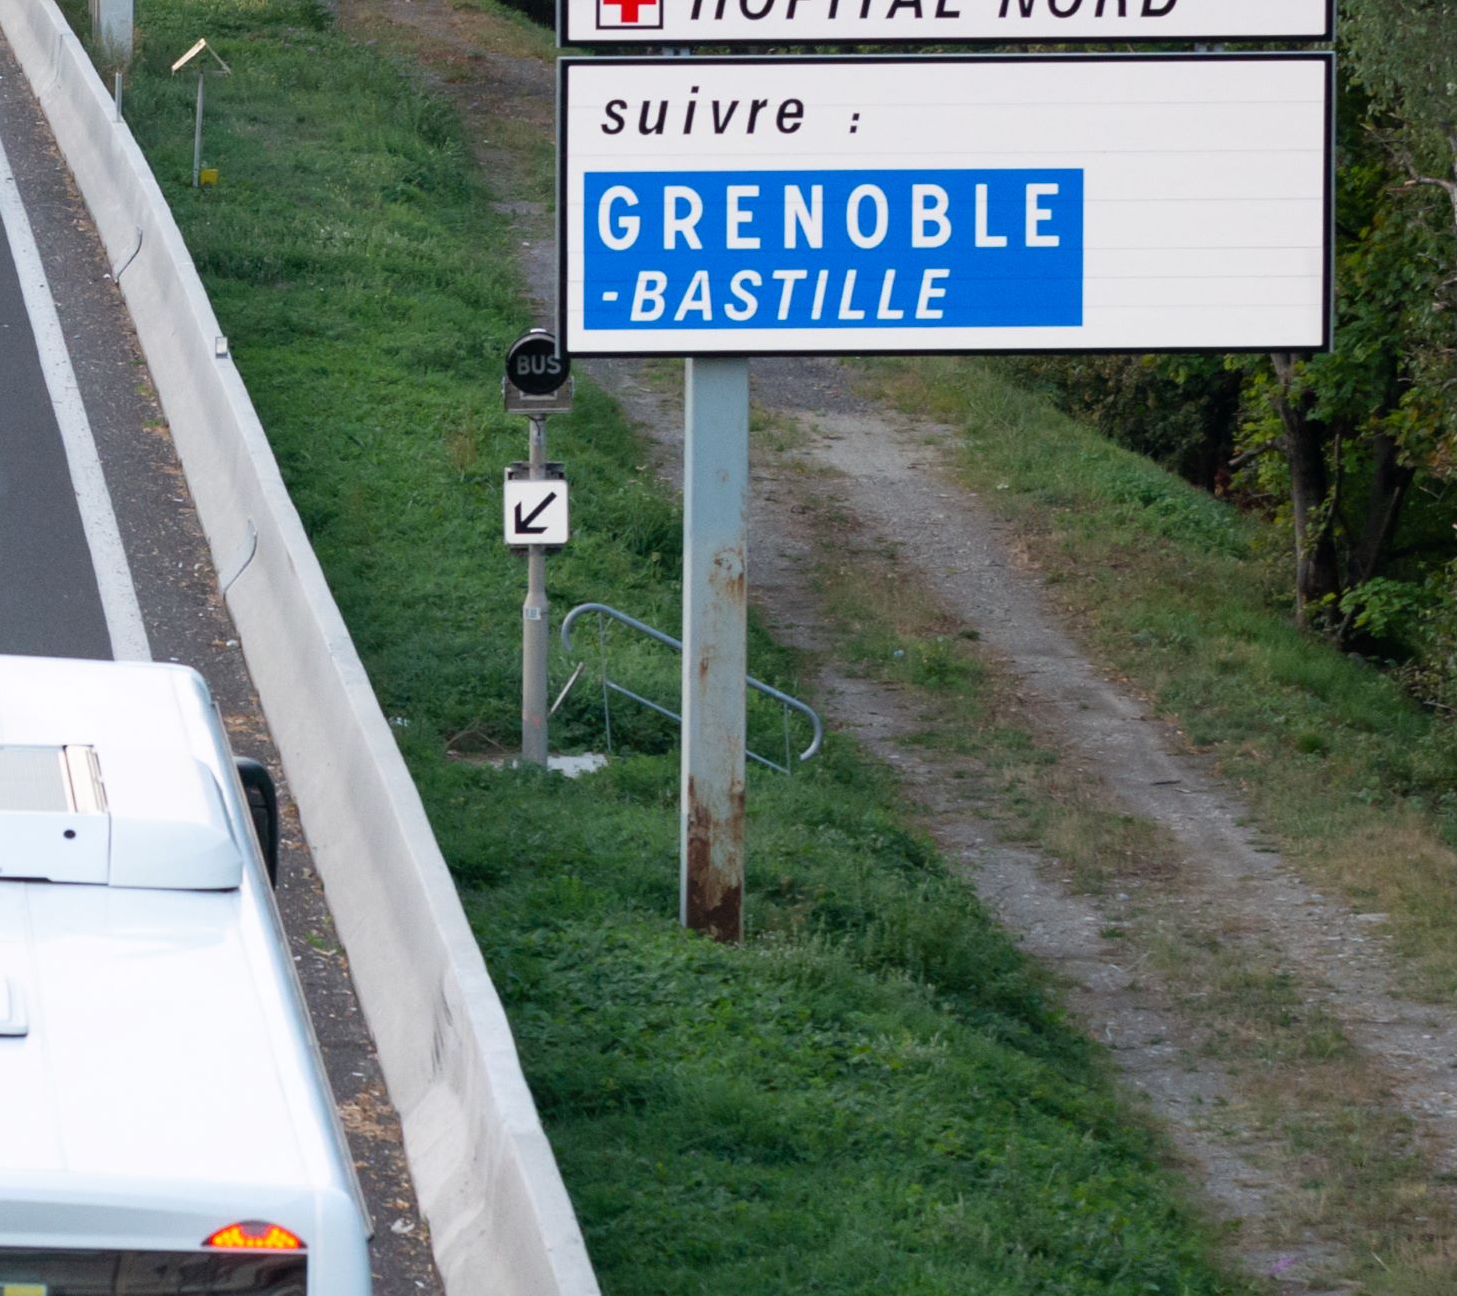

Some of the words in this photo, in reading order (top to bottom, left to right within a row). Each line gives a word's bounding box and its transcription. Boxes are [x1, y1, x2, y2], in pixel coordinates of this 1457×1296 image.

[601, 87, 805, 134] suivre
[597, 183, 1061, 250] GRENOBLE
[601, 269, 949, 321] -BASTILLE
[517, 354, 562, 375] BUS
